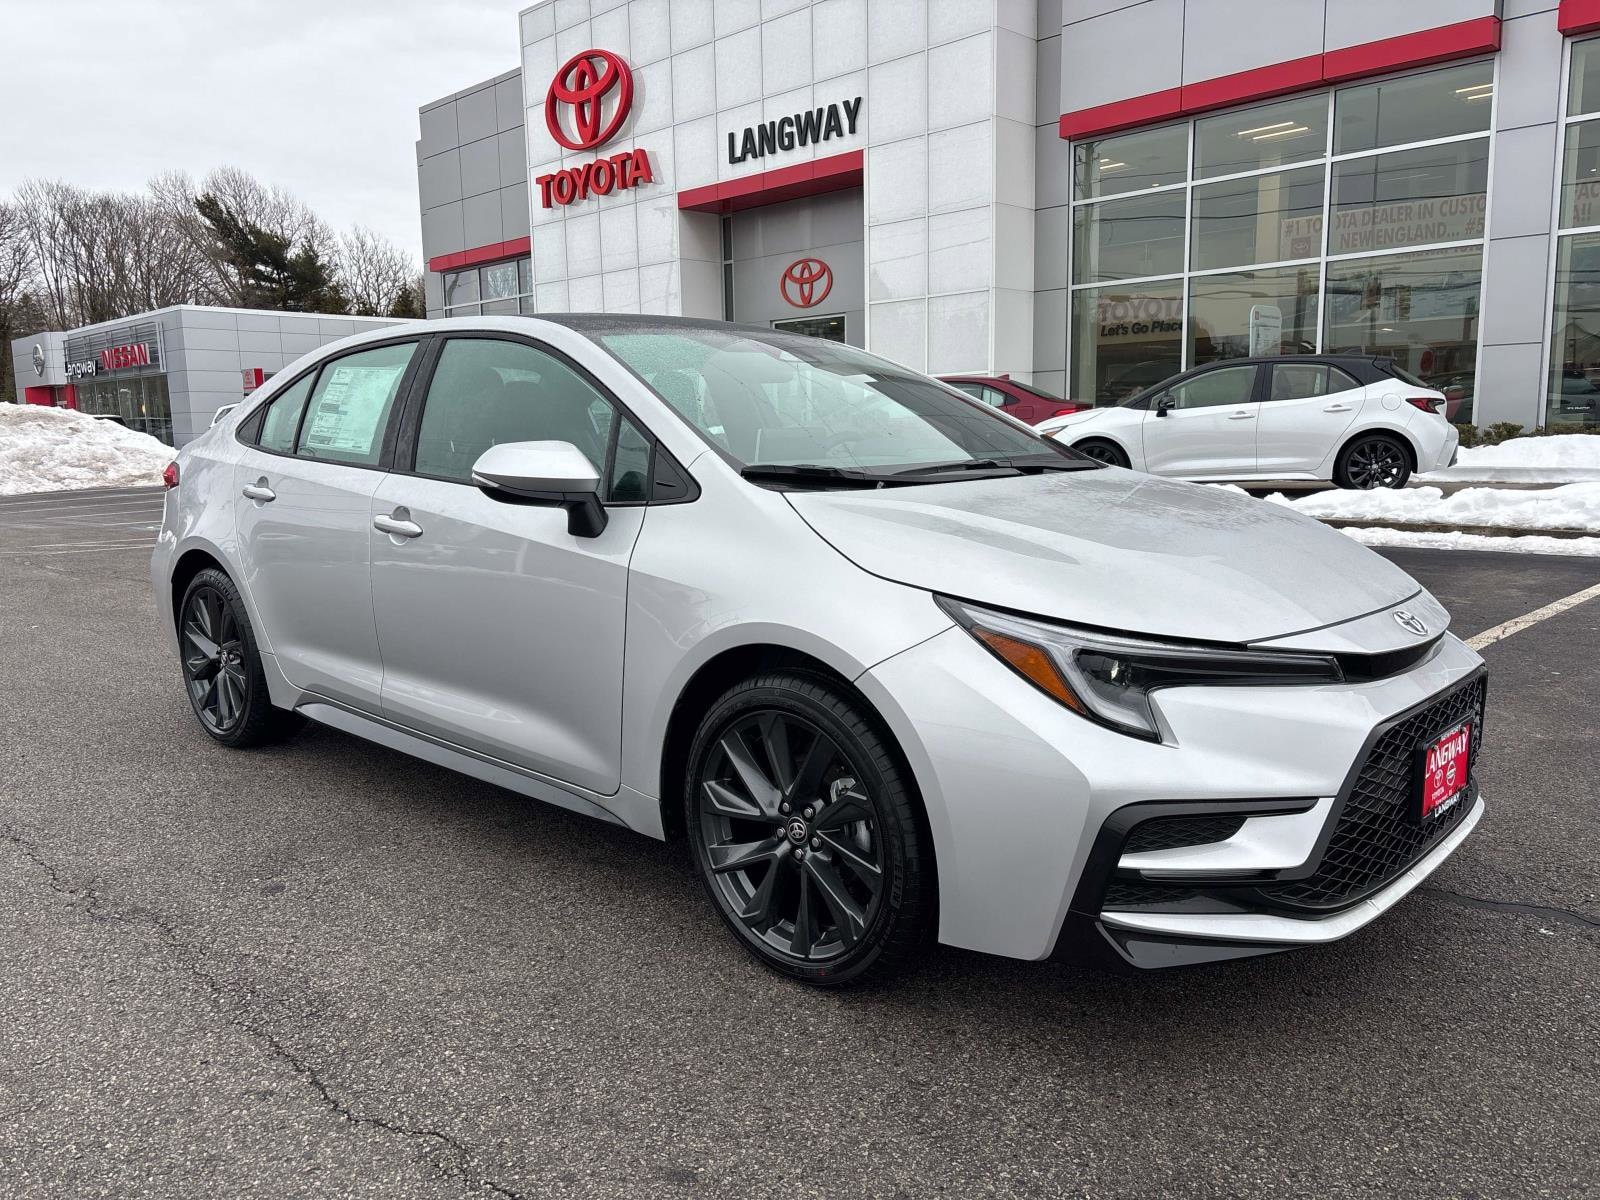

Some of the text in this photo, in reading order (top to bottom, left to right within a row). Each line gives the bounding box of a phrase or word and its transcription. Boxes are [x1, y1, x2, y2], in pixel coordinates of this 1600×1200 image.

[728, 97, 862, 164] LANGWAY
[536, 149, 653, 208] TOYOTA
[1285, 222, 1300, 236] #1
[1305, 212, 1357, 234] TOTA
[1361, 205, 1413, 225] DEALER
[1418, 202, 1434, 219] IN
[1340, 231, 1372, 249] NEW
[1101, 323, 1128, 337] Let's
[1131, 322, 1149, 335] Go
[64, 343, 150, 378] Langway NISSAN
[1425, 731, 1468, 779] LANGWAY
[1435, 791, 1460, 817] LANGWAY
